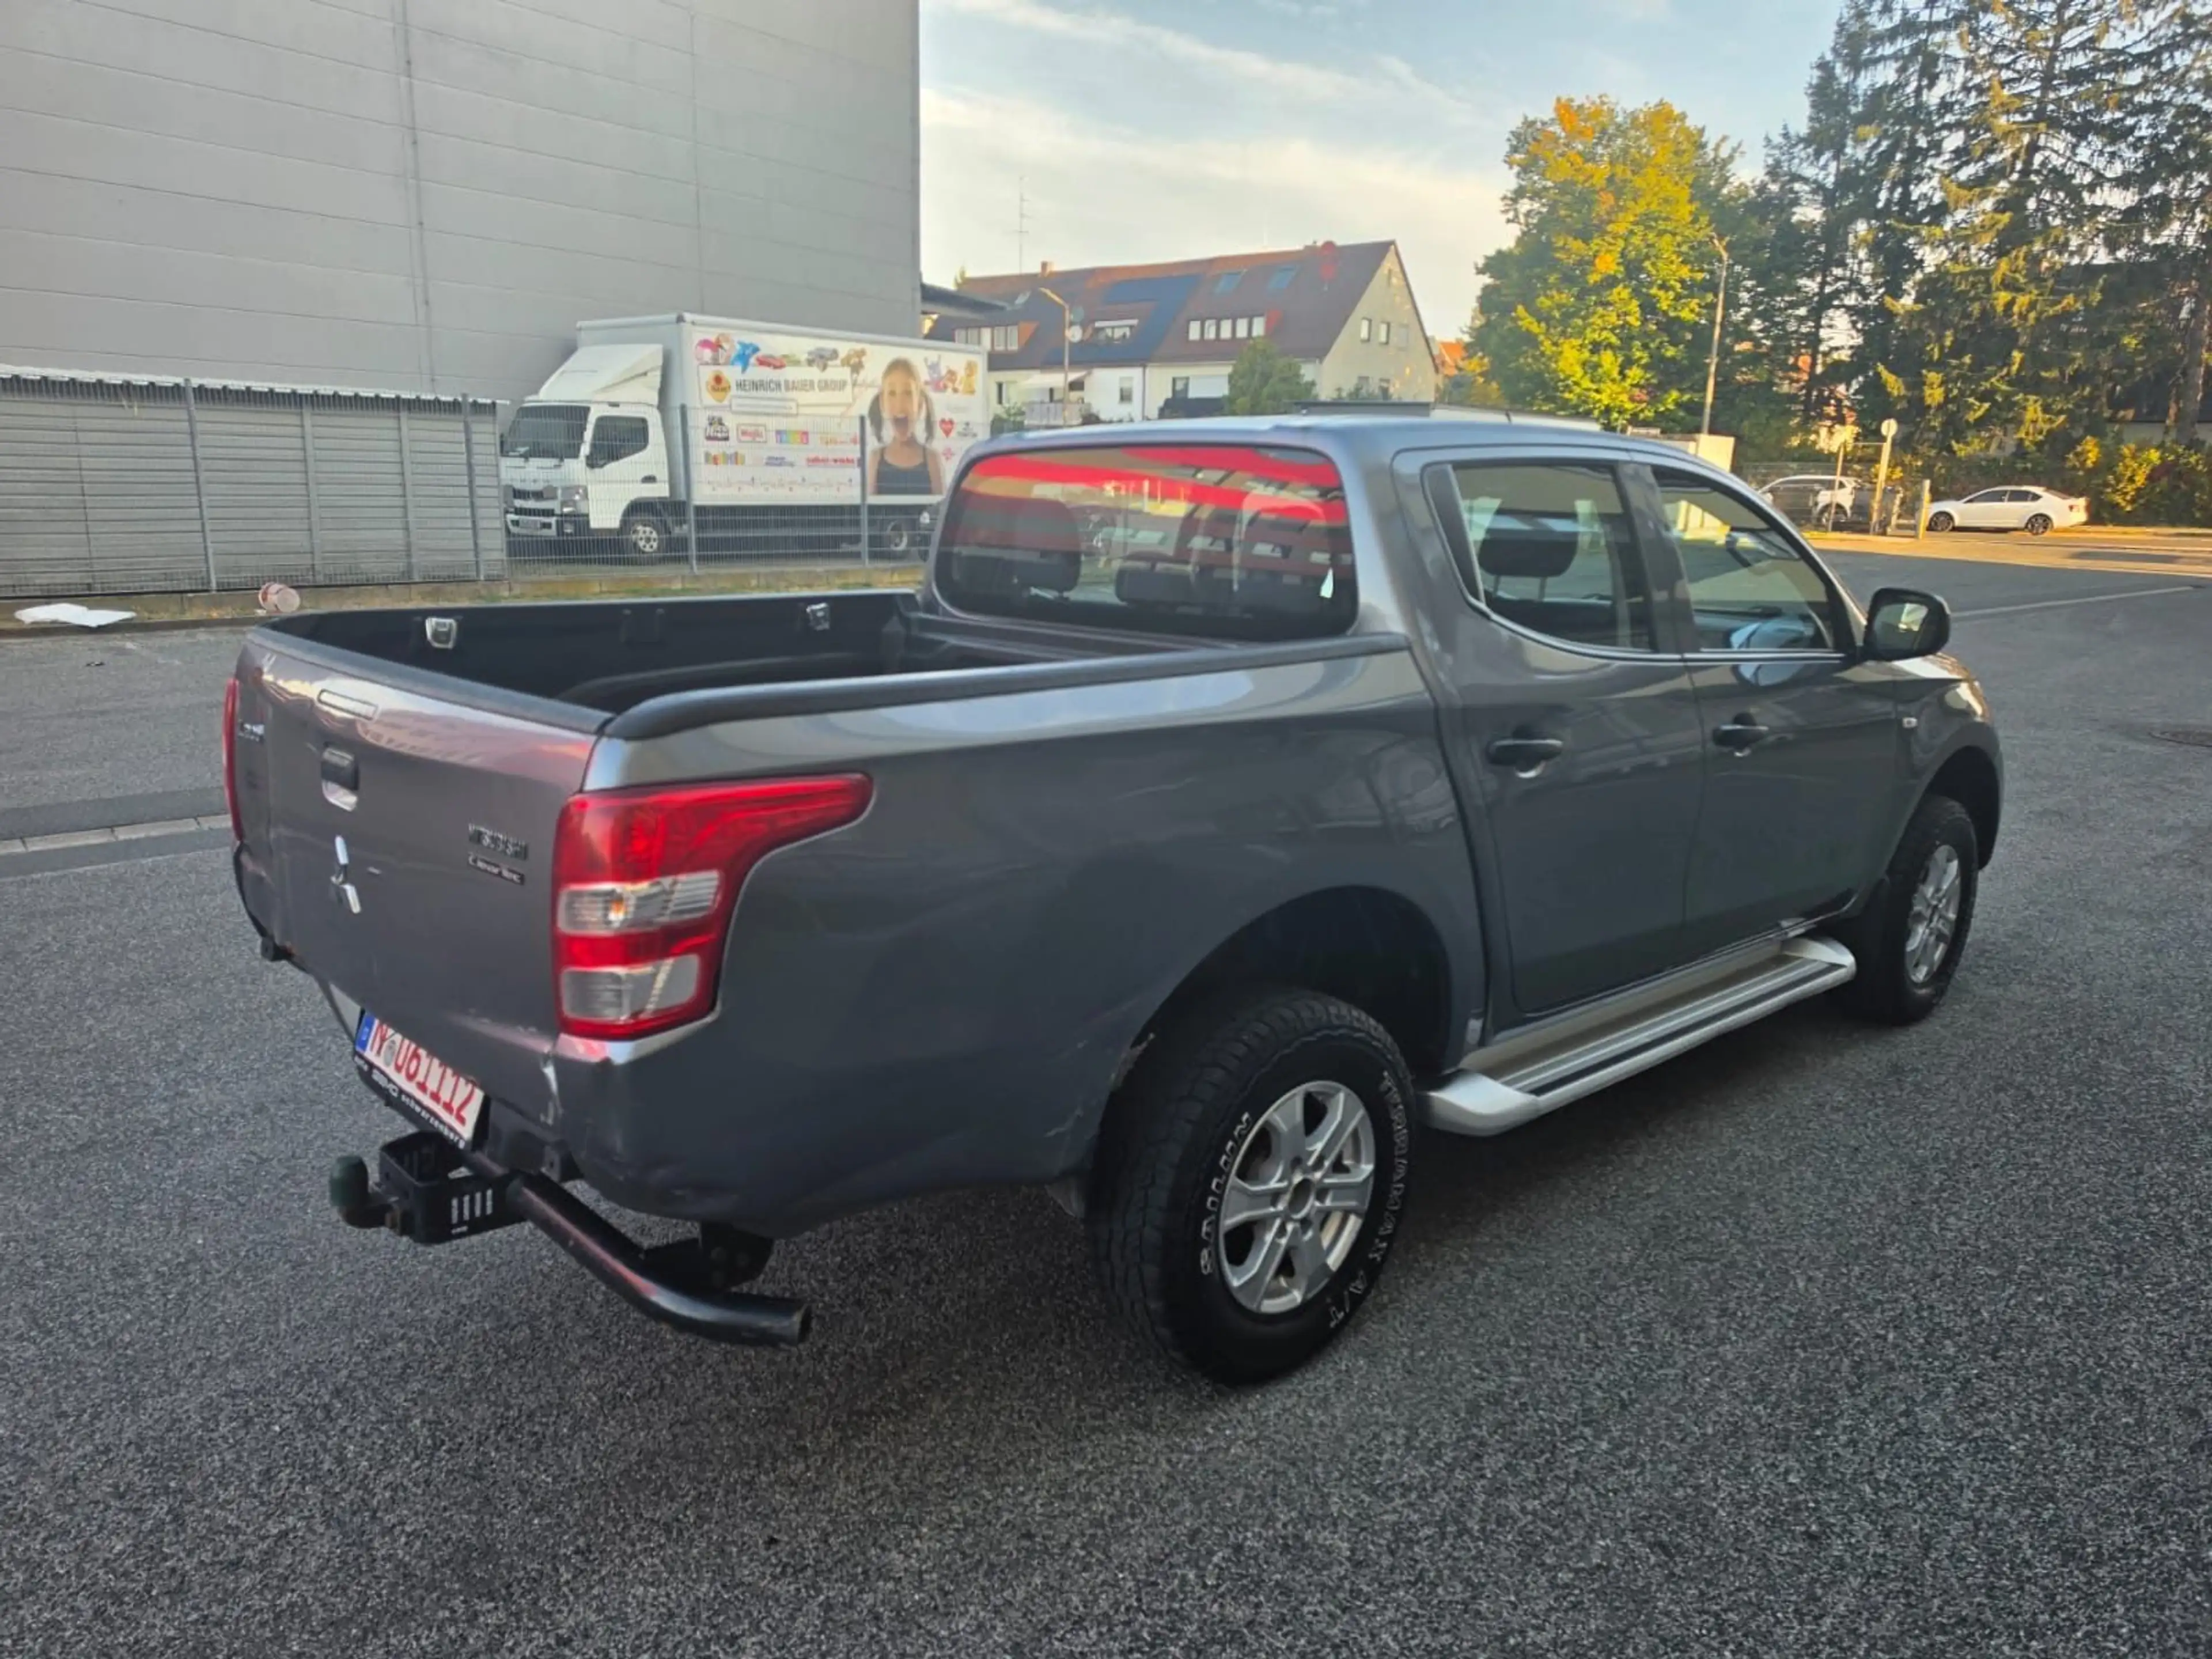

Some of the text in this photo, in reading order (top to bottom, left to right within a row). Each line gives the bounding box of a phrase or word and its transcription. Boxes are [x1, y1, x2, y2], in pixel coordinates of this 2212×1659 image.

[735, 377, 782, 392] HEINRICH
[783, 378, 816, 393] BAUER
[817, 379, 848, 393] GROUP
